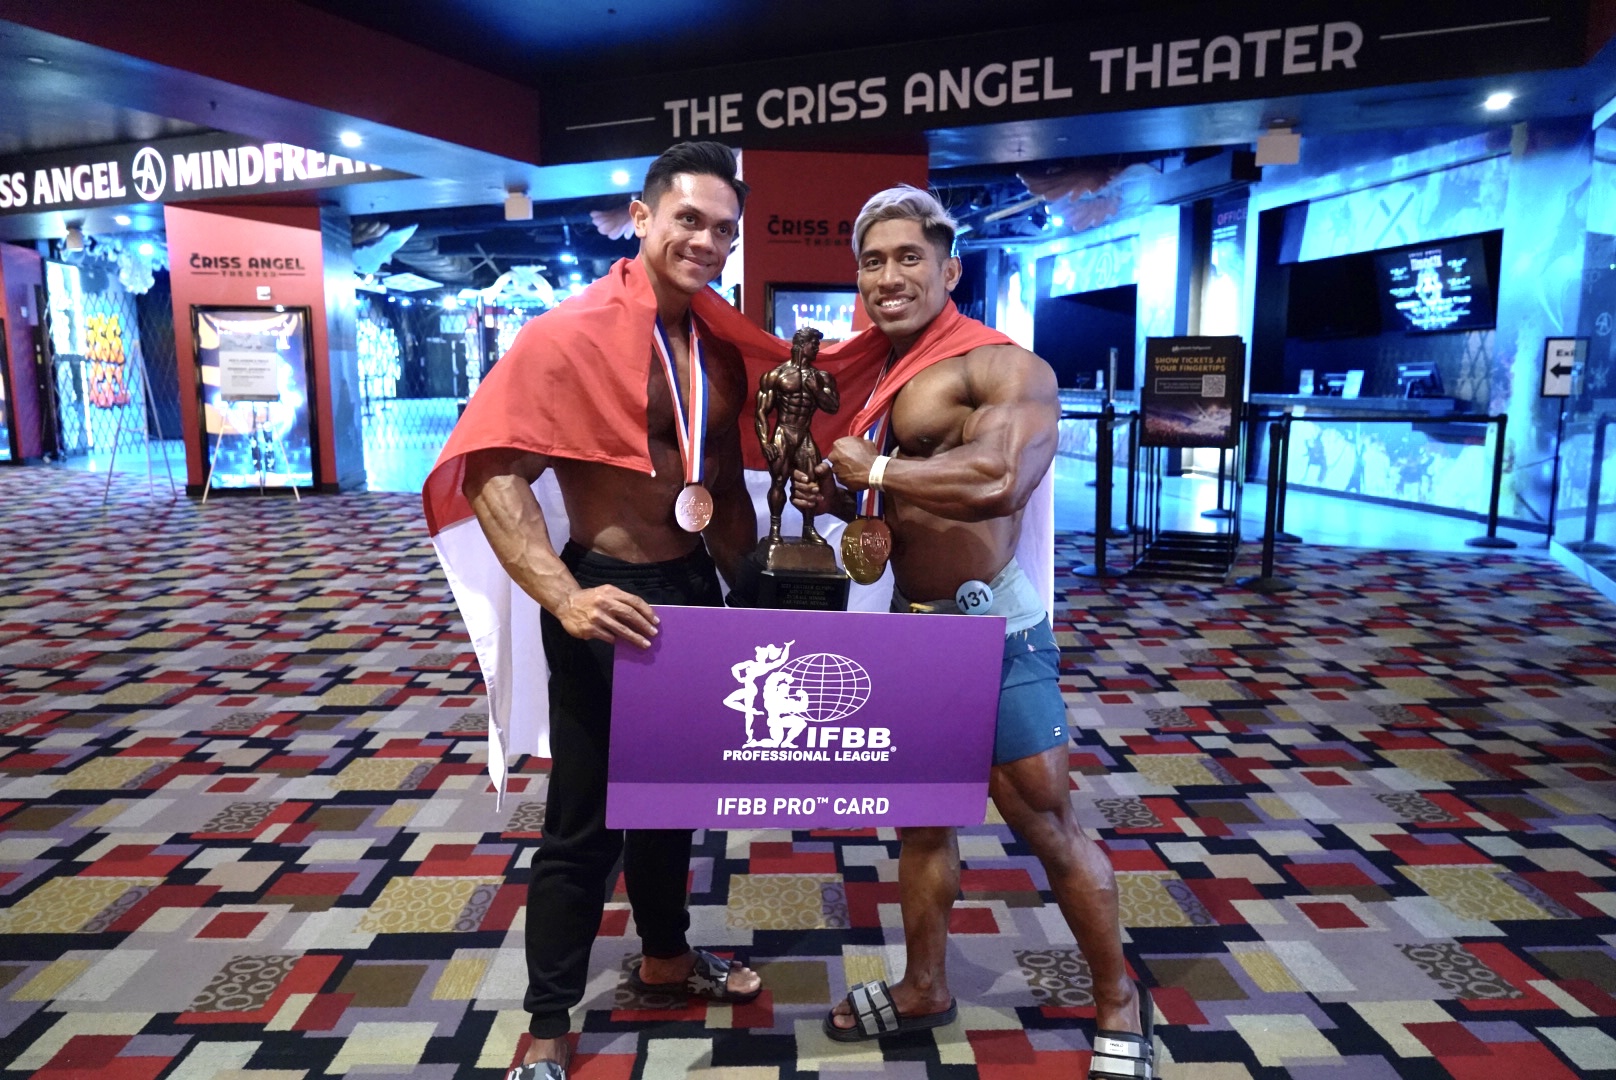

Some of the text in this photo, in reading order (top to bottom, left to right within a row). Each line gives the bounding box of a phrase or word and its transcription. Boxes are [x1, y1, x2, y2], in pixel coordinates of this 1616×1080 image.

[664, 21, 1364, 138] THE CRISS ANGEL THEATER
[33, 161, 127, 205] ANGEL
[248, 257, 305, 270] ANGEL
[958, 588, 989, 610] 131
[806, 727, 891, 749] IFBB
[723, 750, 889, 762] PROFESSIONAL LEAGUE
[716, 797, 767, 815] IFBB
[833, 797, 890, 815] CARD
